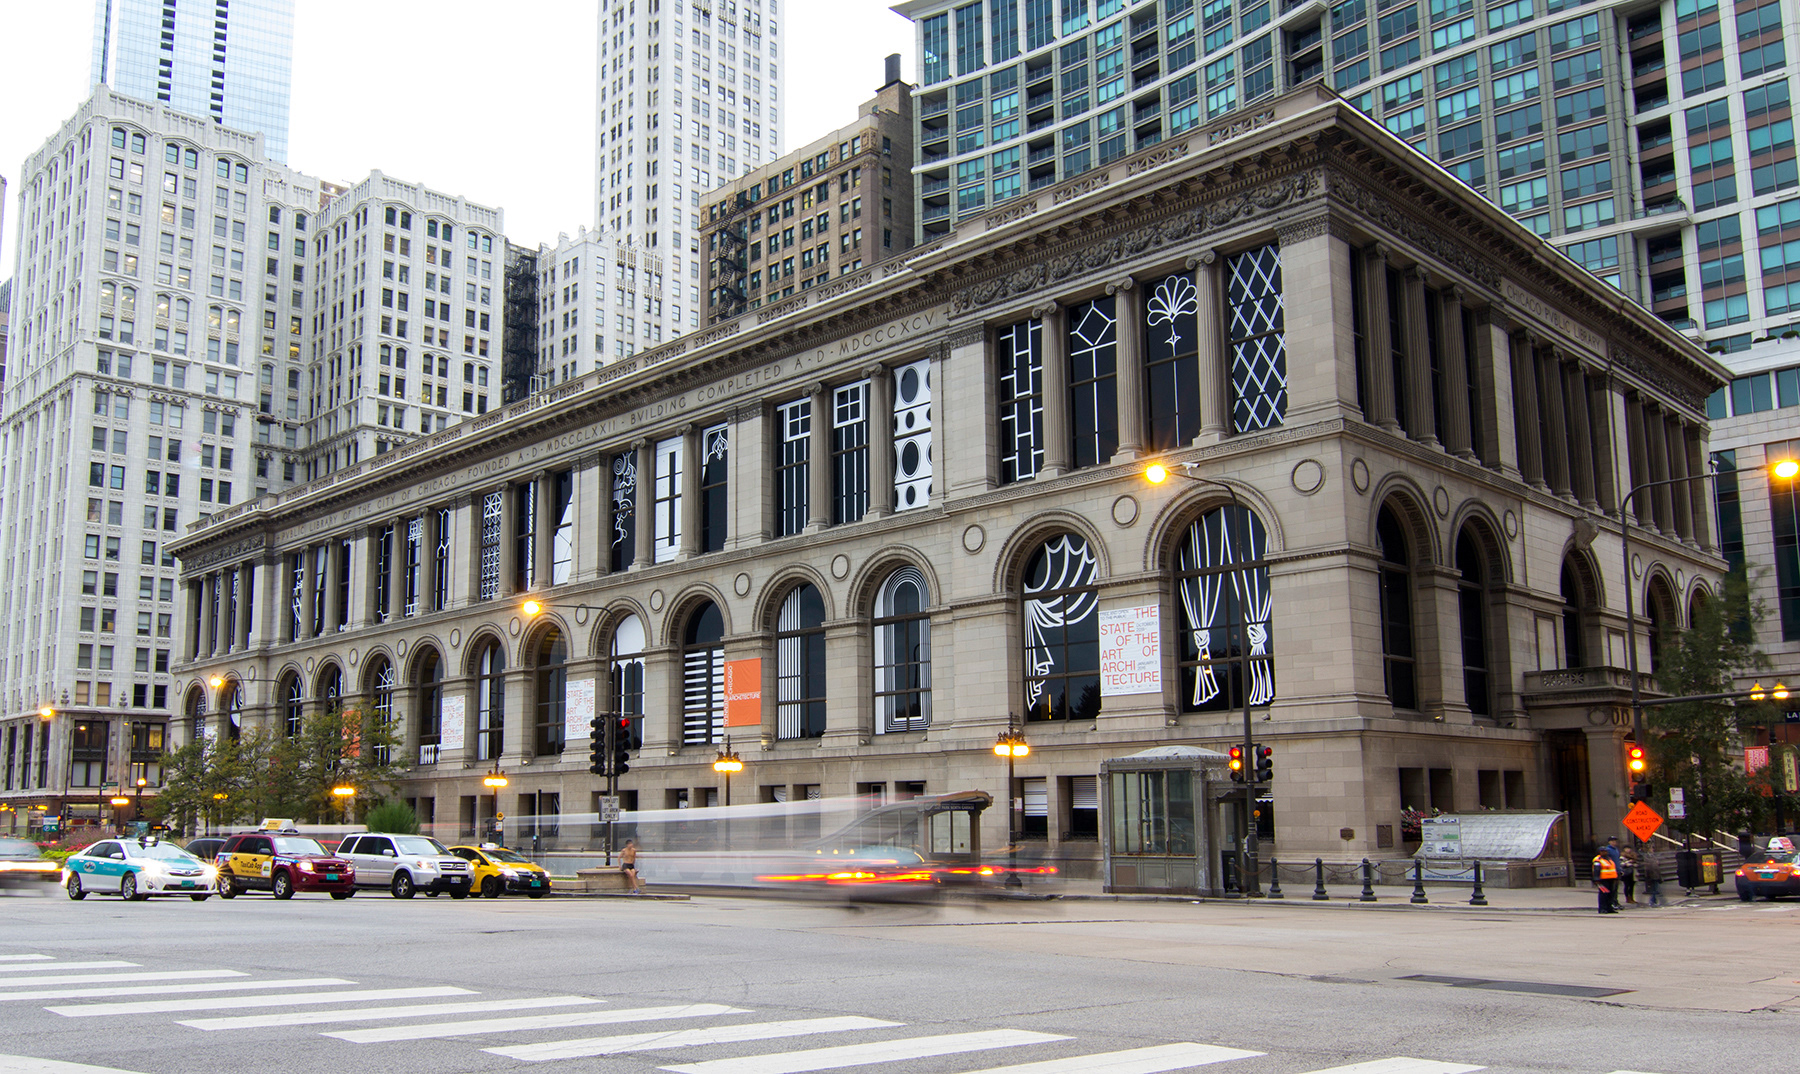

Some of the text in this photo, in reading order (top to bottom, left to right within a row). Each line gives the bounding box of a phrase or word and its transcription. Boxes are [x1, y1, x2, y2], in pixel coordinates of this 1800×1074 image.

[1506, 285, 1541, 316] CHICAGO
[1573, 323, 1601, 351] LIBRARY
[309, 515, 338, 532] LIBRARY
[343, 509, 352, 520] OF
[358, 503, 371, 515] THE
[377, 495, 396, 509] CITY
[401, 489, 412, 500] OF
[417, 474, 457, 496] CHICAGO
[697, 364, 781, 402] COMPLETED
[1133, 606, 1158, 619] THE
[1100, 621, 1135, 636] STATE
[1116, 631, 1158, 647] OF THE
[1101, 644, 1158, 661] ART OF
[1101, 660, 1136, 673] ARCHI
[583, 679, 594, 688] THE
[1105, 670, 1160, 686] TECTURE
[567, 689, 583, 699] STATE
[729, 691, 761, 701] ARCHITECTURE
[575, 696, 594, 706] OF THE
[567, 705, 593, 715] ART OF
[567, 715, 582, 723] ARCHI
